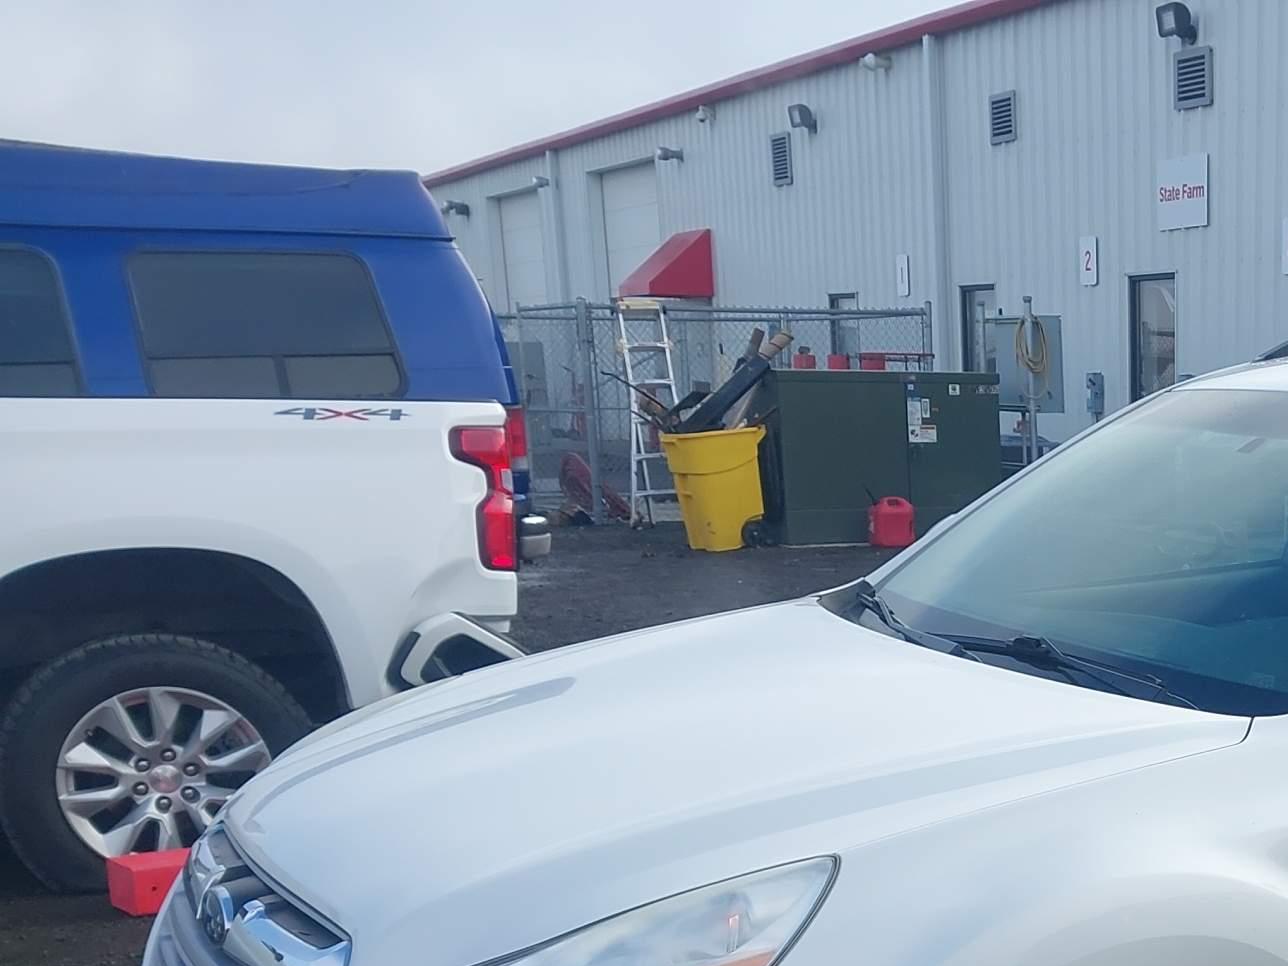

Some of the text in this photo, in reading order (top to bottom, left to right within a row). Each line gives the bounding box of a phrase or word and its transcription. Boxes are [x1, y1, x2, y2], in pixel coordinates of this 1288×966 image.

[1159, 183, 1205, 203] State Farm
[1084, 250, 1092, 271] 2
